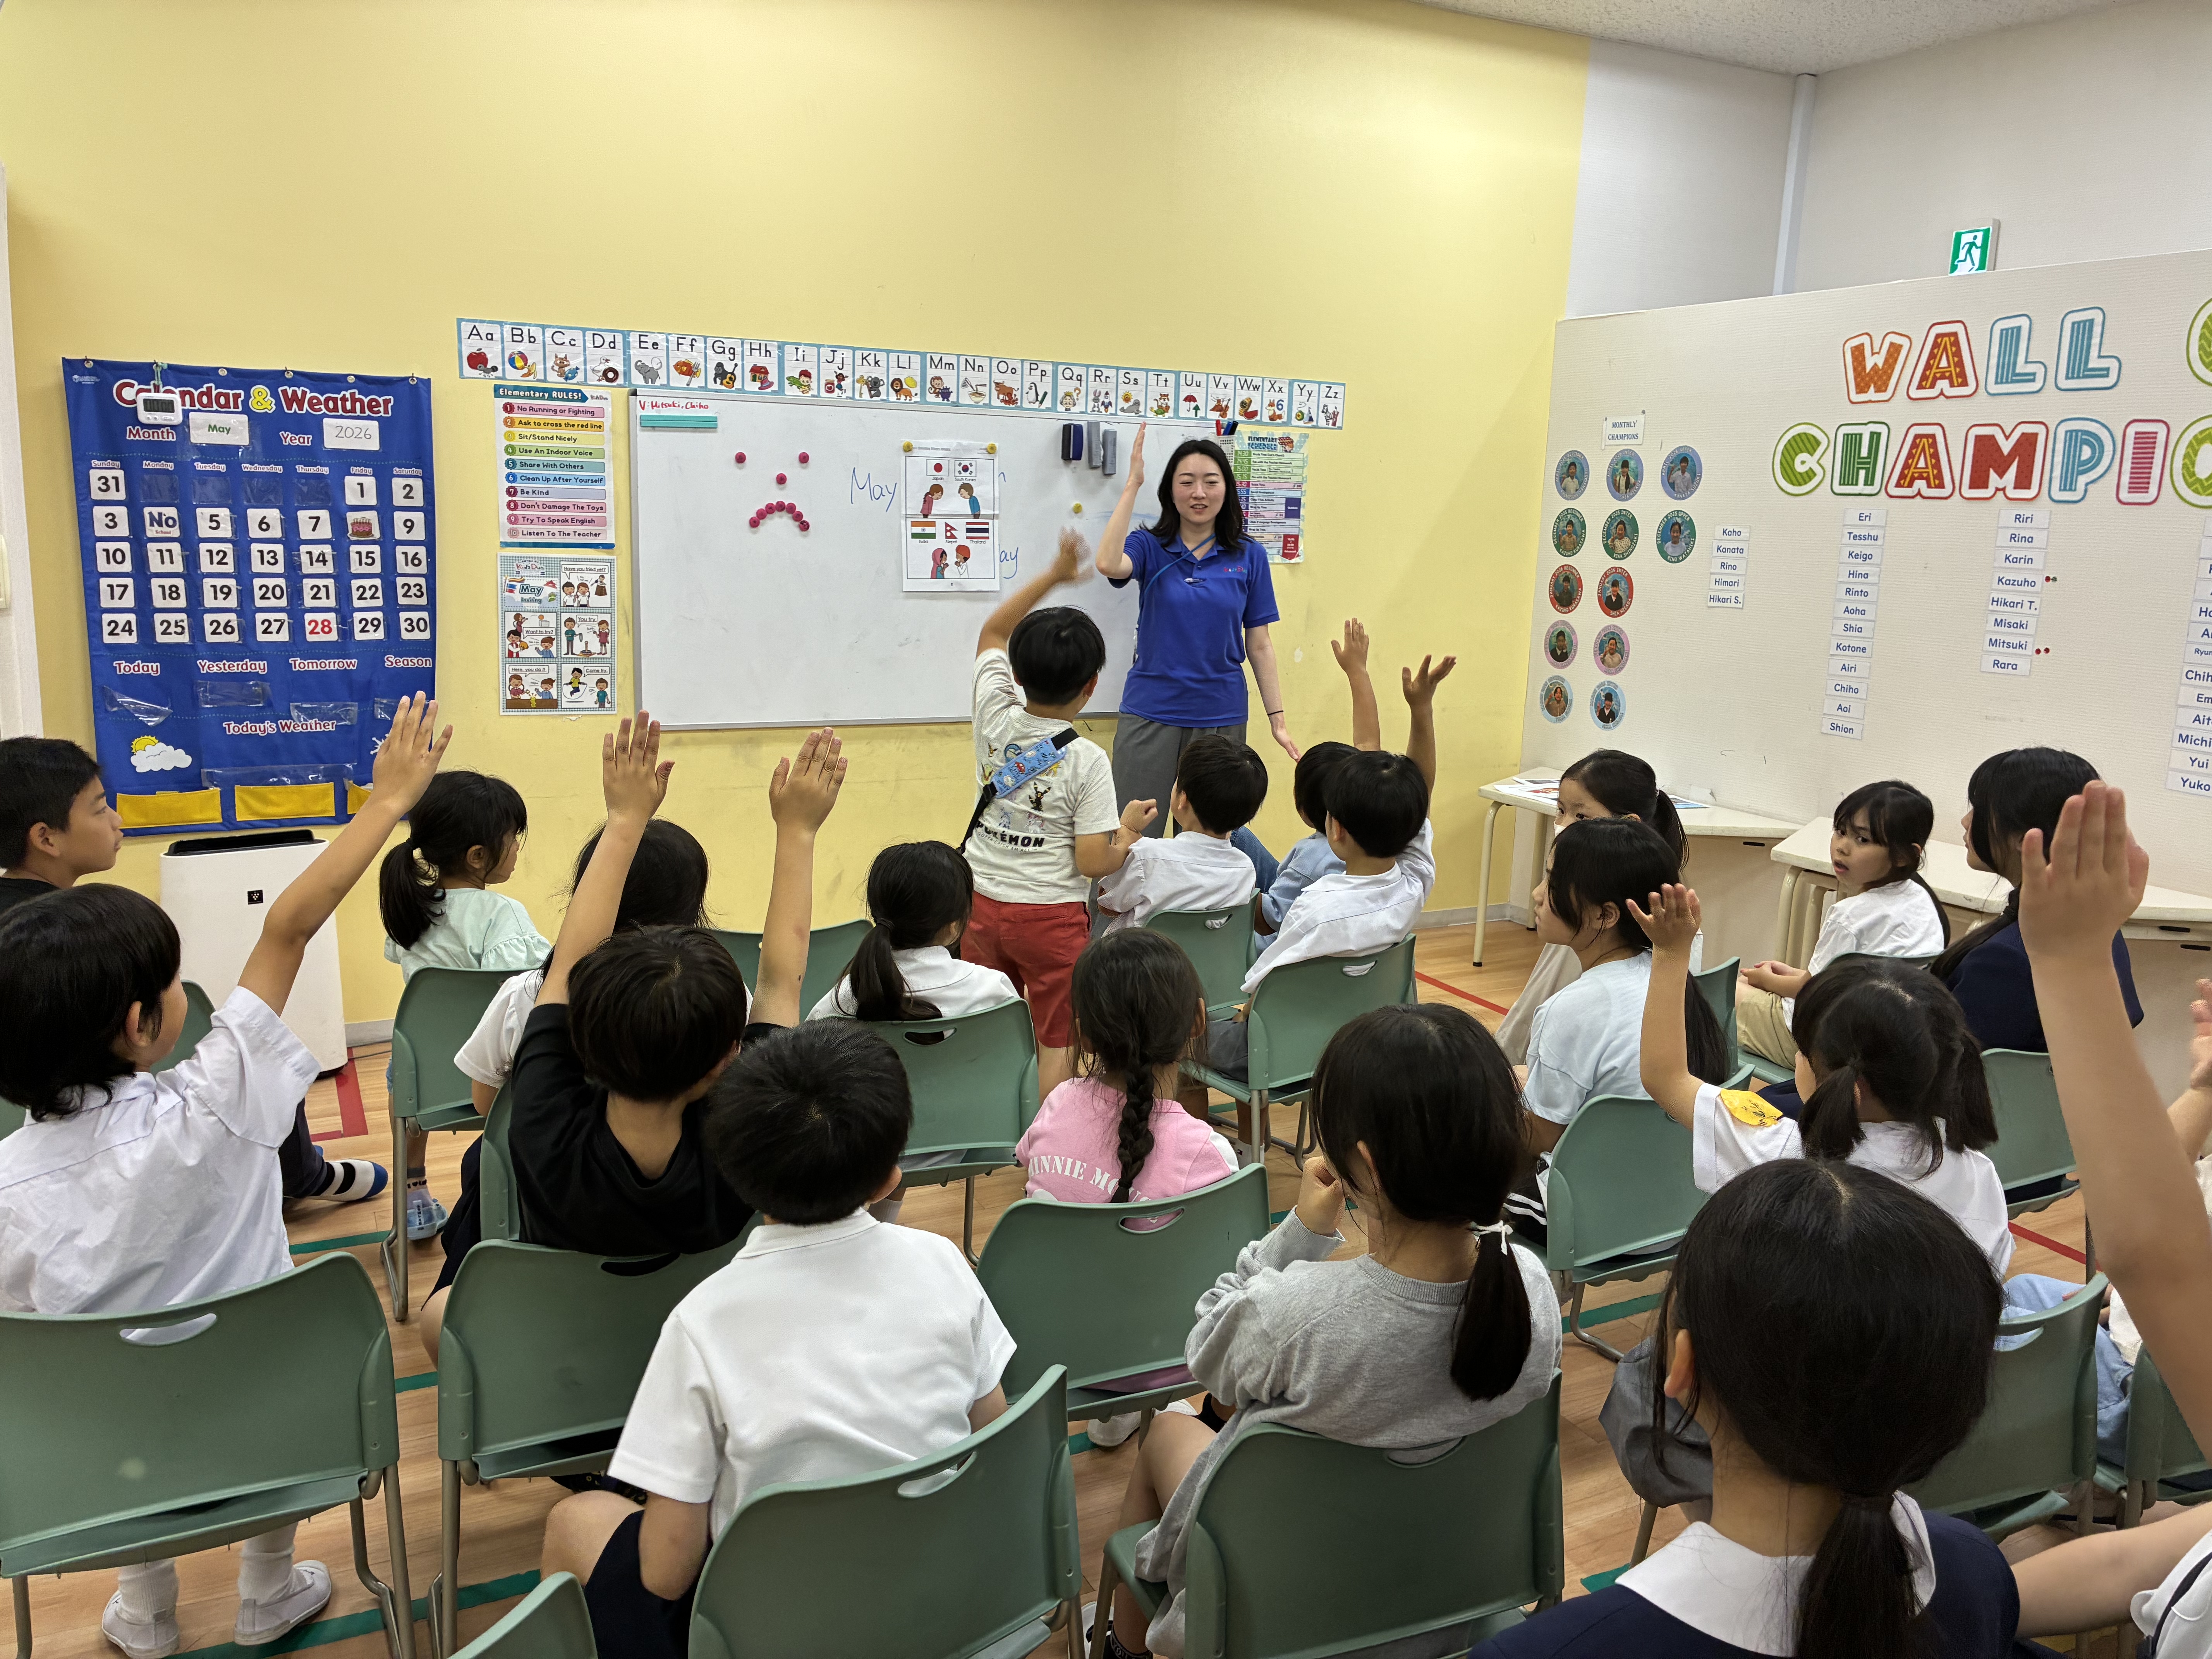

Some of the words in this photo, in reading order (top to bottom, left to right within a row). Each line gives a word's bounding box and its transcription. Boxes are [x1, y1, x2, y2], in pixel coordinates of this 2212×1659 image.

[1843, 306, 2121, 404] WALL
[115, 382, 242, 410] Cndar
[251, 388, 274, 412] &
[283, 389, 391, 415] Weather
[500, 388, 548, 399] Elementary
[552, 391, 581, 399] RULES!
[529, 406, 557, 414] Running
[1612, 420, 1637, 428] MONTHLY
[128, 428, 175, 440] Month
[208, 424, 231, 434] May
[282, 432, 311, 445] Year
[335, 426, 372, 440] 2026
[144, 461, 173, 469] Monday
[196, 463, 225, 471] Tuesday
[243, 465, 282, 473] Wednesday
[394, 468, 422, 476] Saturday
[98, 476, 120, 493] 31
[357, 482, 364, 498] 1
[402, 484, 414, 499] 2
[851, 467, 897, 512] May
[105, 512, 118, 529] 3
[148, 511, 177, 528] No
[208, 514, 221, 531] 5
[258, 515, 270, 532] 6
[308, 516, 321, 532] 7
[403, 519, 415, 534] 9
[1859, 513, 1872, 521] Eri
[2014, 514, 2033, 524] Riri
[1723, 528, 1741, 536] Kaho
[1847, 532, 1878, 541] Tesshu
[2009, 533, 2033, 544] Rina
[1717, 545, 1744, 554] Kanata
[102, 548, 126, 565] 10
[156, 548, 174, 565] 11
[206, 549, 228, 565] 12
[257, 549, 279, 566] 13
[306, 550, 328, 567] 14
[355, 551, 375, 567] 15
[401, 551, 422, 567] 16
[1848, 551, 1873, 562] Keigo
[2004, 554, 2033, 565] Karin
[1721, 562, 1737, 570] Rino
[1848, 570, 1869, 579] Hina
[1715, 578, 1740, 587] Himari
[1997, 576, 2036, 587] Kazuho
[106, 584, 129, 601] 17
[158, 584, 181, 601] 18
[210, 584, 232, 601] 19
[259, 584, 284, 600] 20
[310, 584, 330, 600] 21
[356, 584, 380, 601] 22
[401, 582, 424, 599] 23
[521, 586, 543, 596] May
[1845, 587, 1869, 598] Rinto
[1709, 594, 1732, 604] Hikari
[1734, 596, 1741, 604] S.
[1991, 597, 2023, 609] Hikari
[2027, 600, 2038, 611] T.
[1843, 606, 1866, 615] Aoha
[107, 620, 134, 636] 24
[160, 620, 185, 635] 25
[209, 620, 235, 635] 26
[261, 619, 286, 635] 27
[308, 619, 333, 635] 28
[359, 617, 381, 633] 29
[404, 617, 428, 633] 30
[1843, 623, 1863, 633] Shia
[1994, 618, 2028, 630] Misaki
[1836, 642, 1867, 653] Kotone
[1989, 637, 2028, 650] Mitsuki
[115, 661, 159, 675] Today
[199, 660, 266, 674] Yesterday
[290, 659, 357, 670] Tomorrow
[386, 656, 432, 668] Season
[1841, 663, 1857, 673] Airi
[1993, 659, 2018, 670] Rara
[1834, 683, 1859, 694] Chiho
[1837, 703, 1851, 713] Aoi
[225, 722, 275, 736] Today's
[280, 720, 336, 732] Weather
[1829, 722, 1853, 734] Shion
[2189, 756, 2209, 769] Yui
[2181, 777, 2211, 791] Yuko
